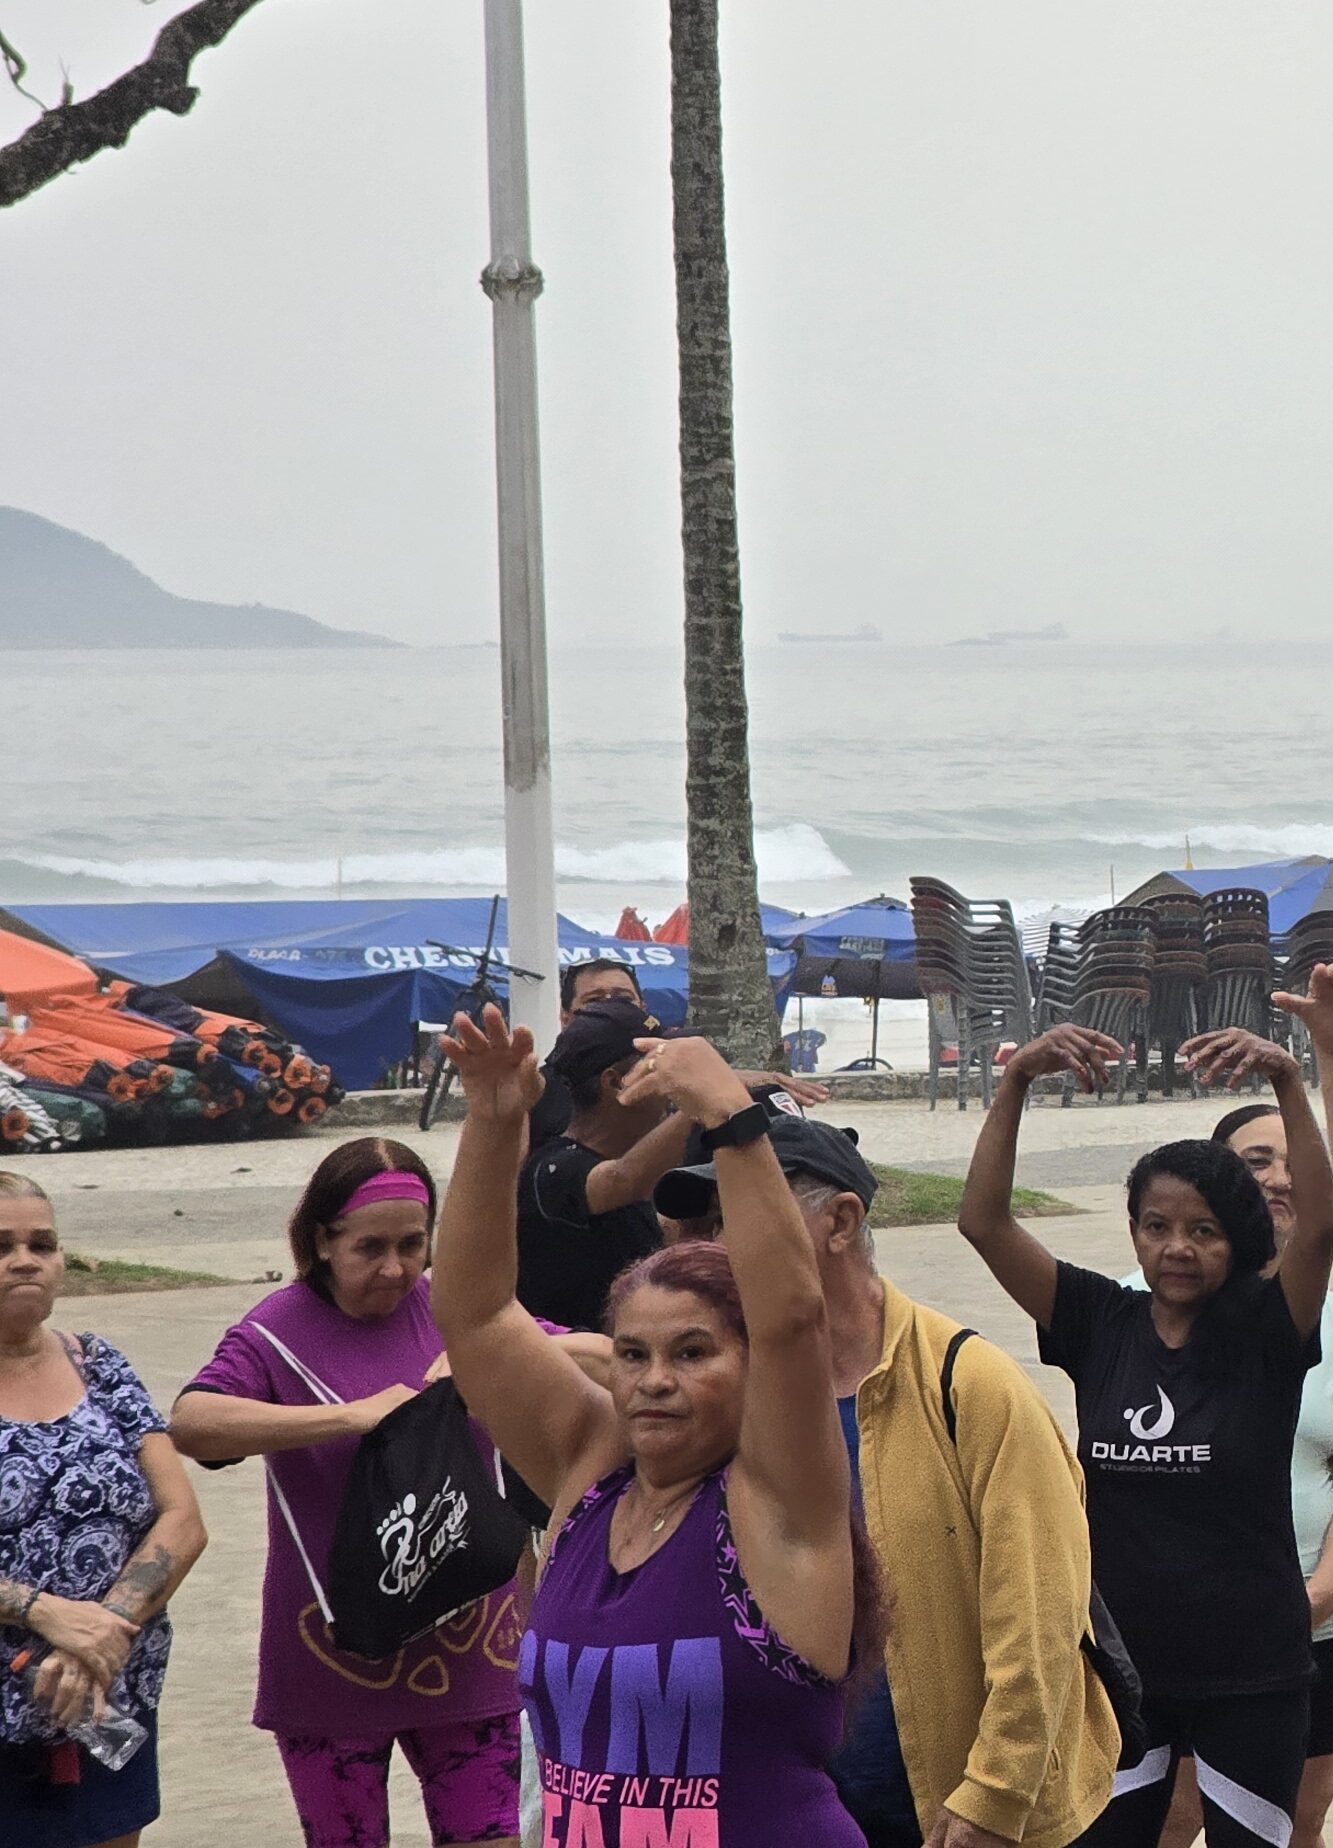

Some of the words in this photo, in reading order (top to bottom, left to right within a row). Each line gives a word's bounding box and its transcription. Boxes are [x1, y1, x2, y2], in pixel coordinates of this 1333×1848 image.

[558, 946, 676, 966] MAIS
[1091, 1441, 1212, 1463] DUARTE
[545, 1758, 615, 1804] BELIEVE
[619, 1776, 650, 1806] IN
[659, 1777, 720, 1807] THIS
